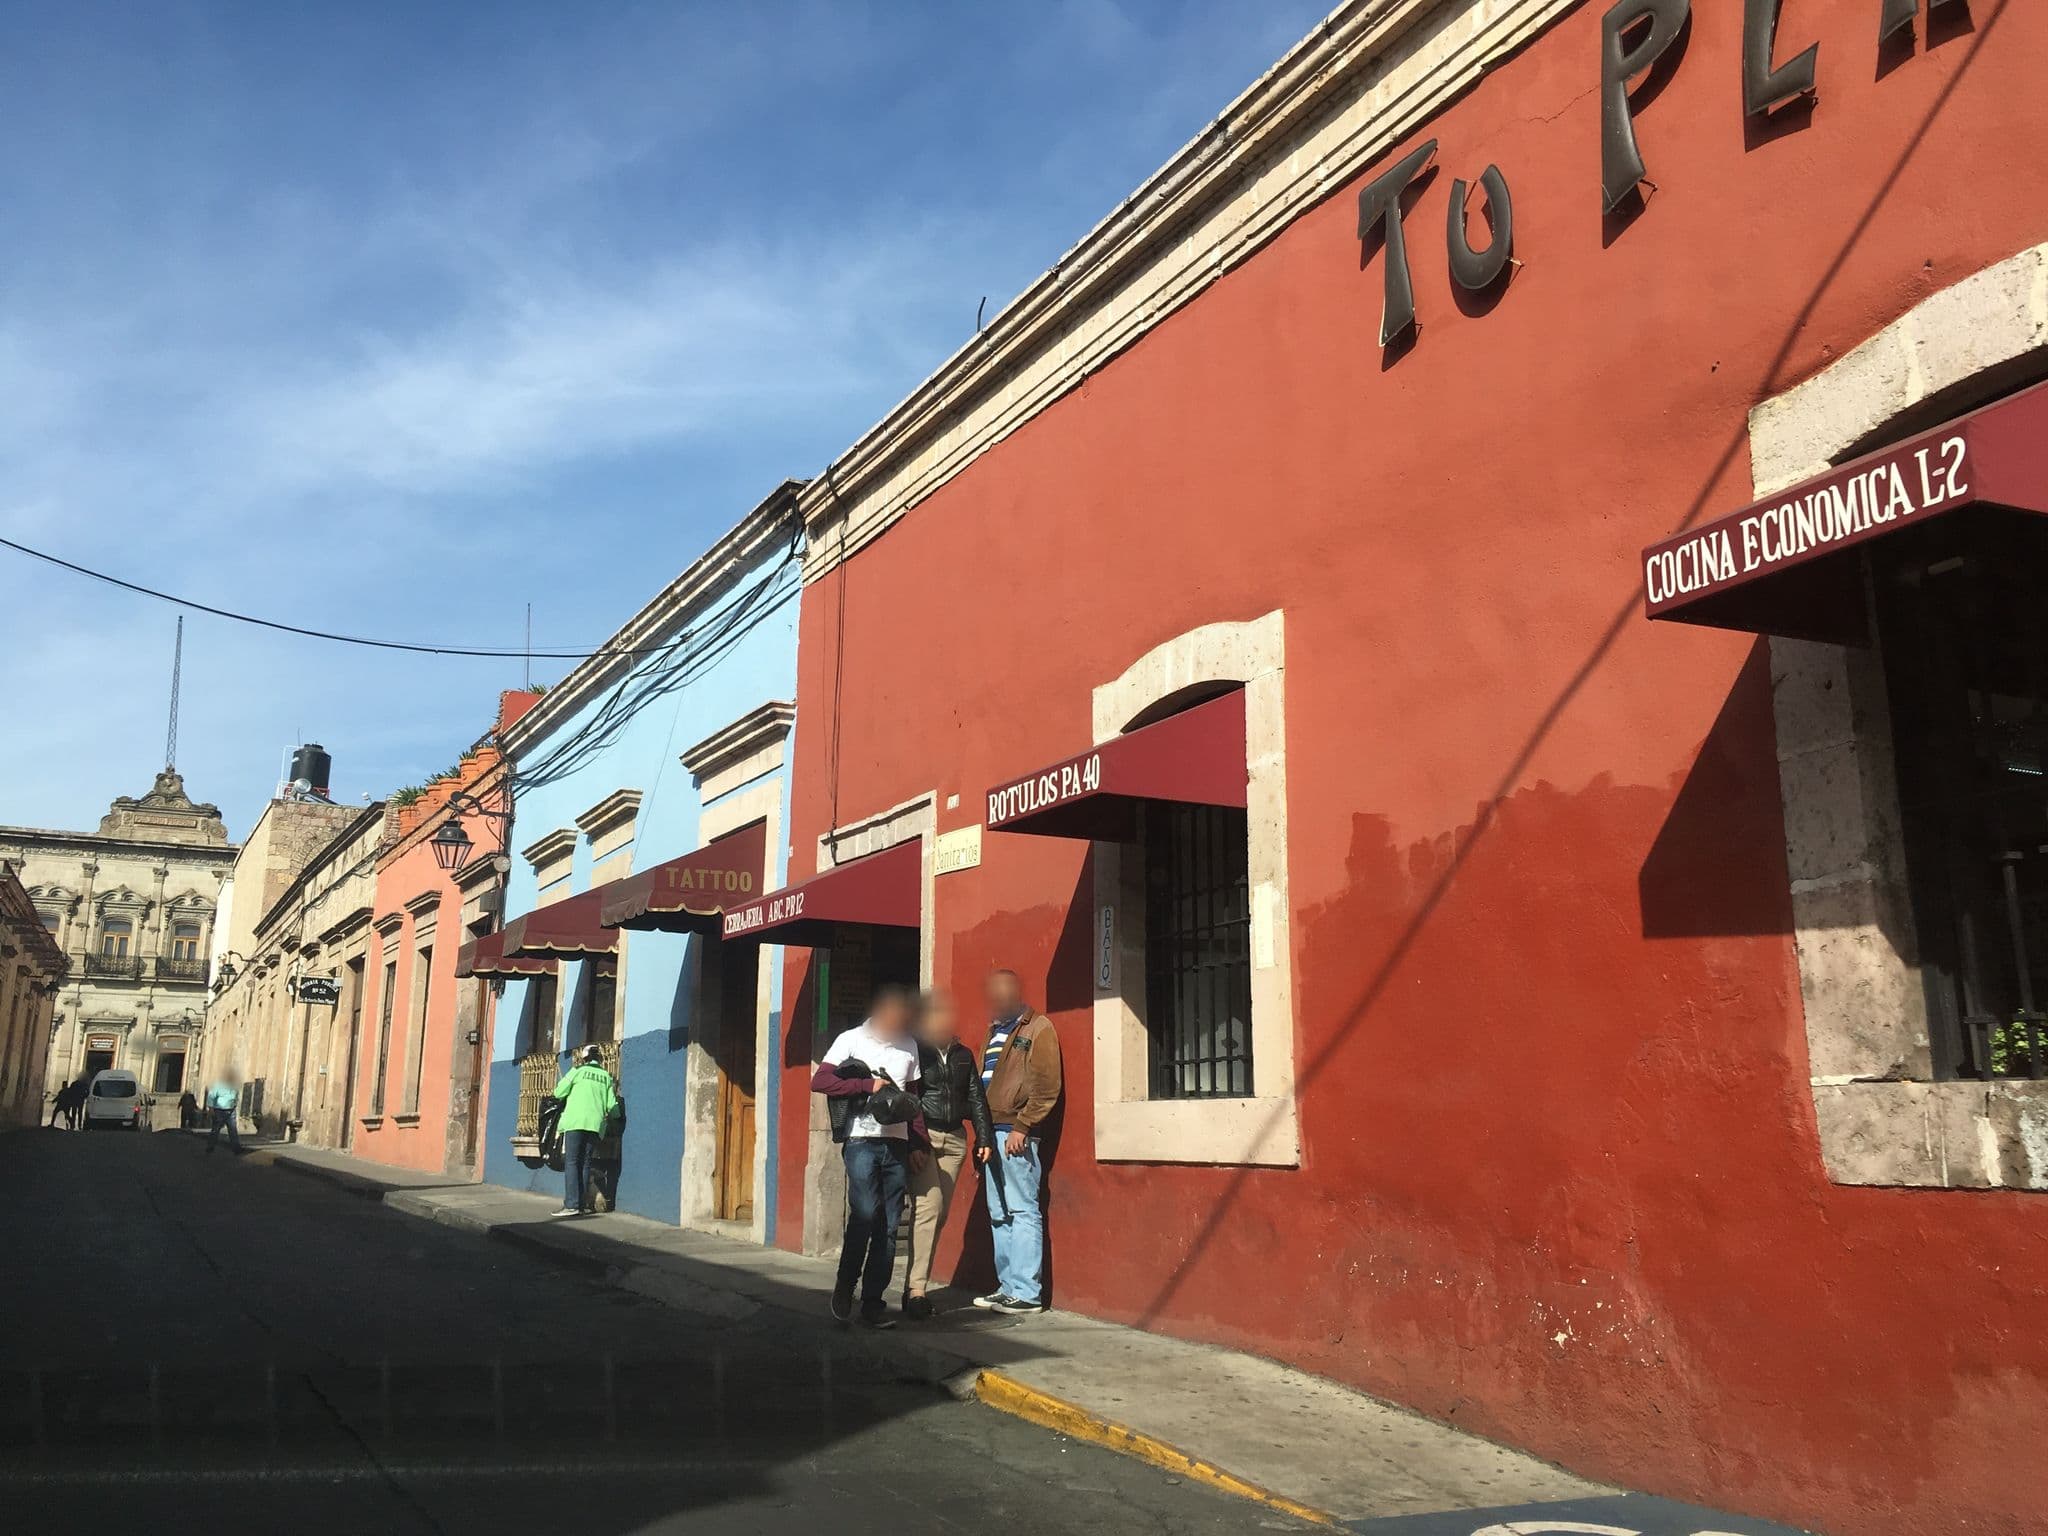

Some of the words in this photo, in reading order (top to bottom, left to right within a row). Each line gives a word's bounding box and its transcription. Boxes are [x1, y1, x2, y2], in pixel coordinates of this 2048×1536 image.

[1601, 0, 1975, 216] PL
[1646, 528, 1738, 604] COCINA
[1739, 462, 1914, 571] ECONOMICA
[1914, 436, 1969, 508] L-2
[988, 770, 1059, 825] ROTULOS
[1082, 754, 1100, 791] 40
[665, 866, 752, 892] TATTOO
[724, 905, 764, 934] CERRAJERIA
